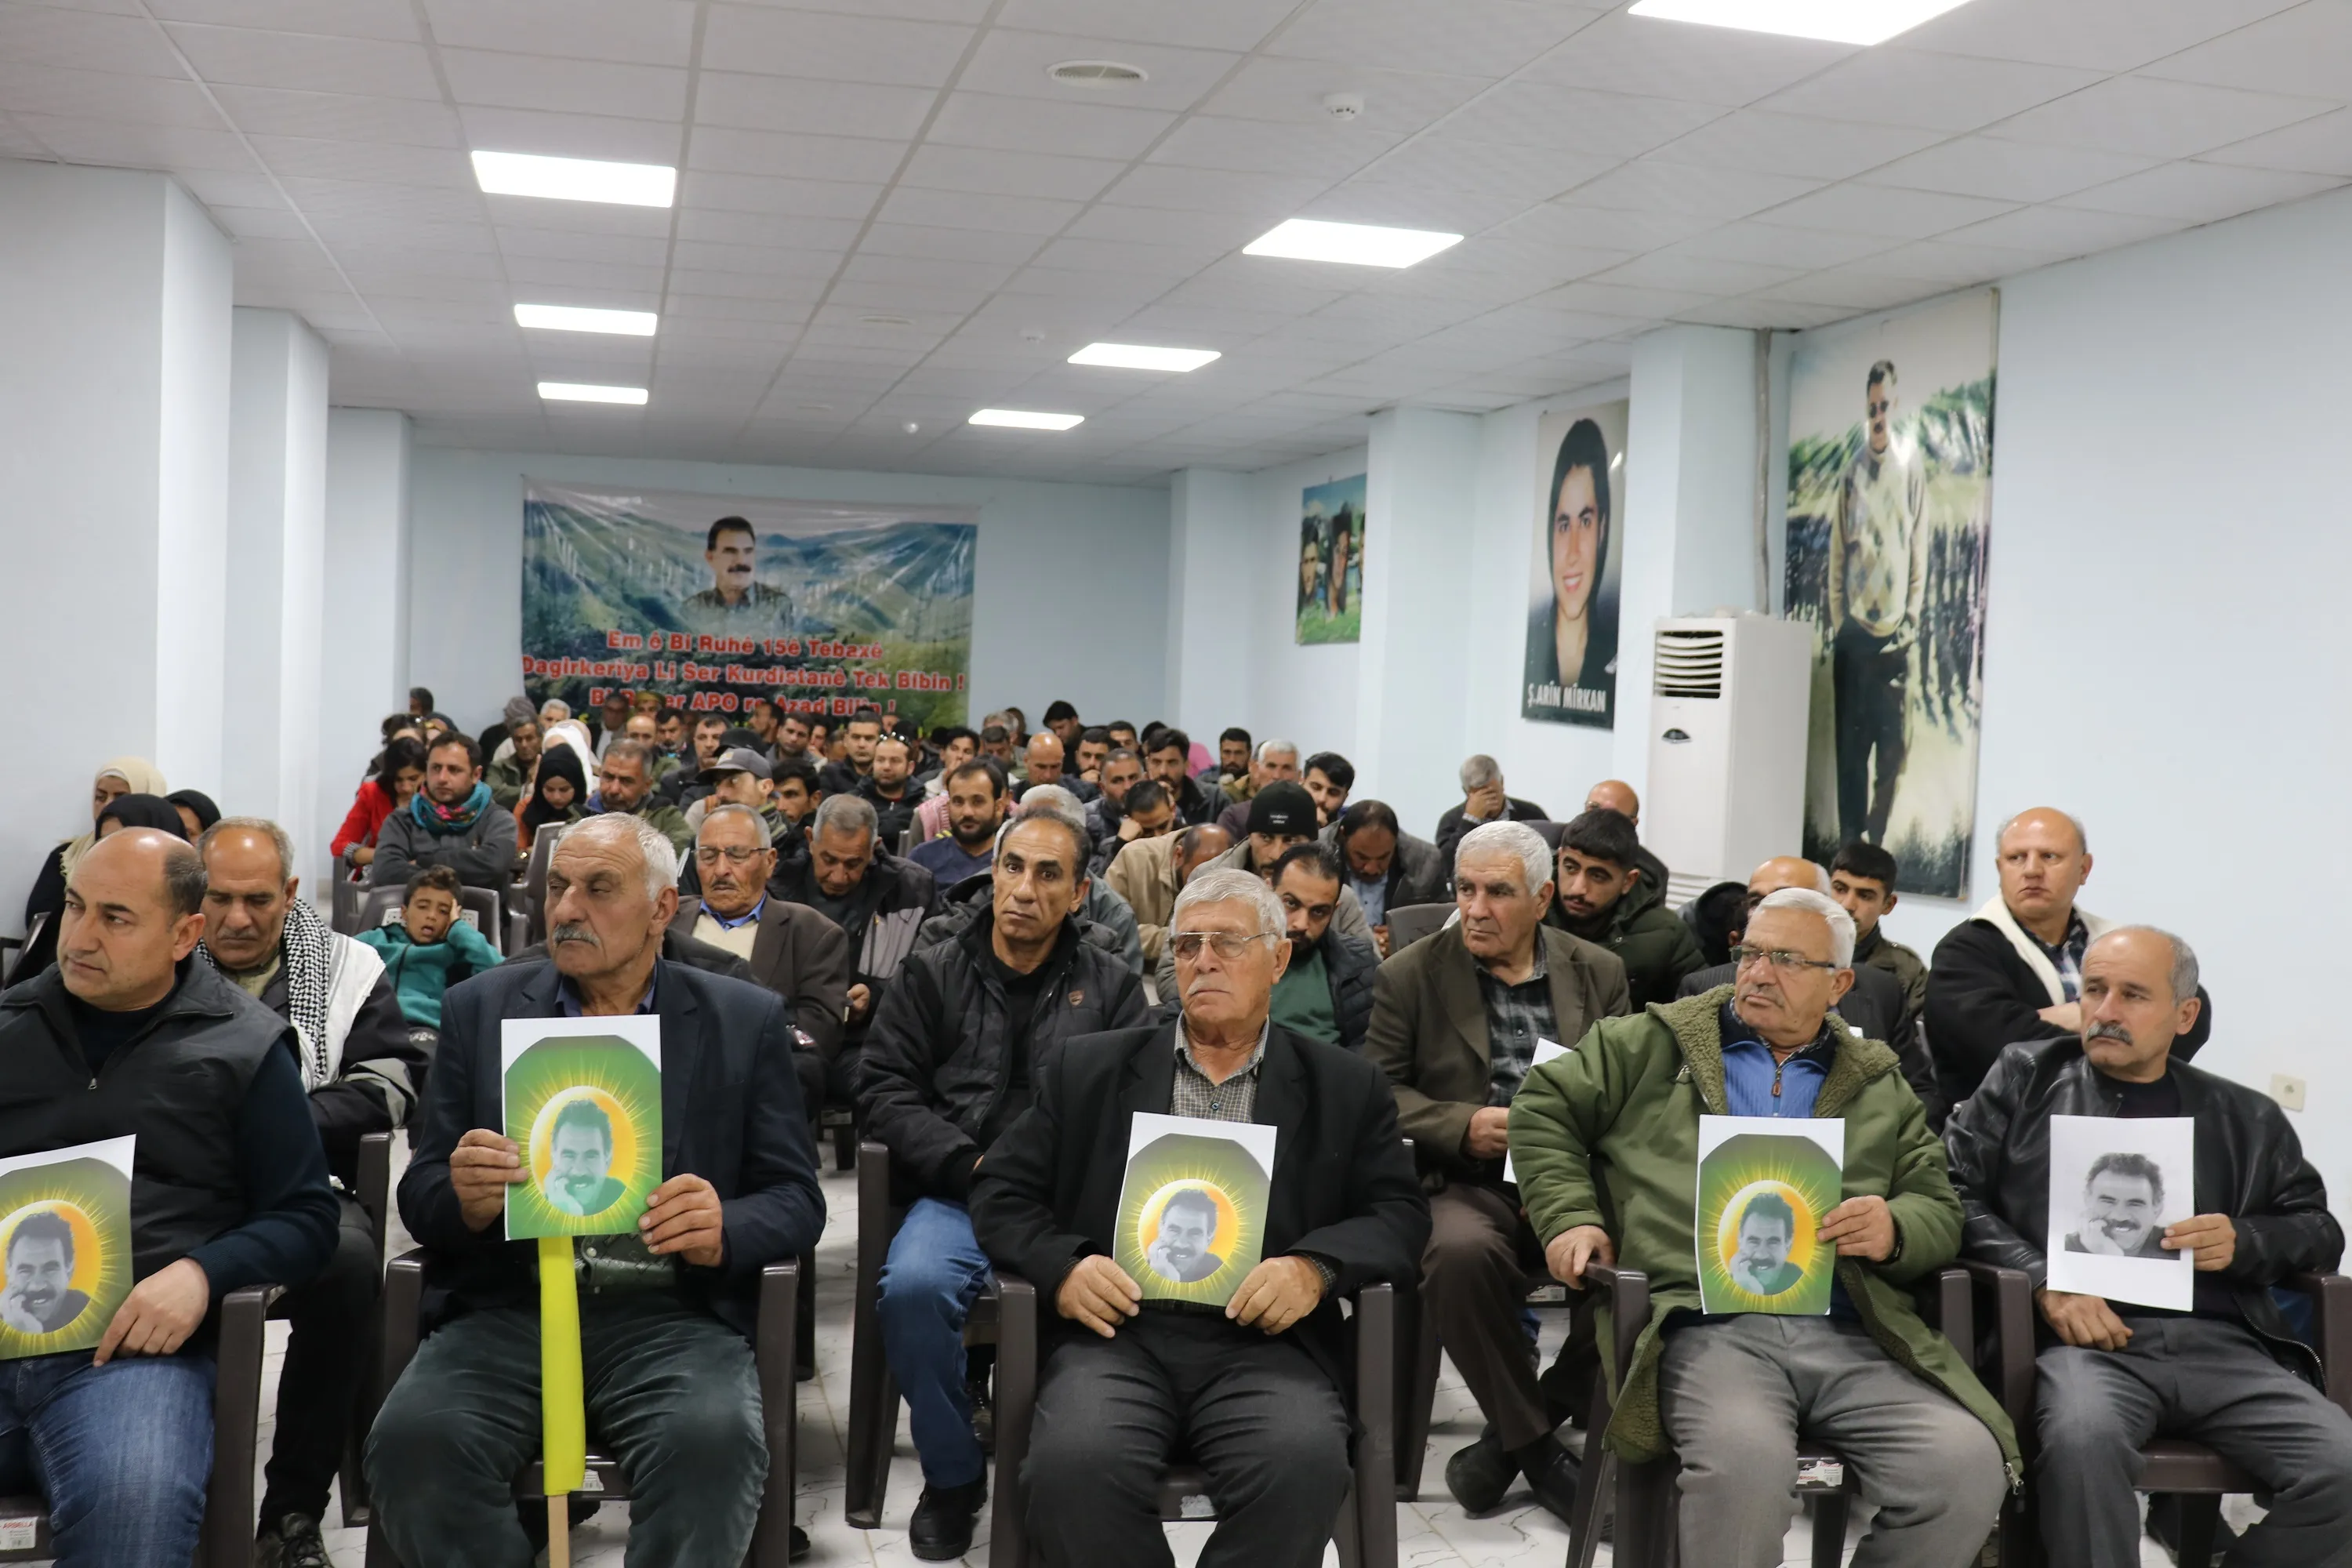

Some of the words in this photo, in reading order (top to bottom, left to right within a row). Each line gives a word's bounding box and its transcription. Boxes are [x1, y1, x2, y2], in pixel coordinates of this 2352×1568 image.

[607, 630, 643, 650] Em
[670, 633, 691, 652] Bi
[699, 634, 755, 655] Ruhê
[764, 638, 801, 657] 15ê
[522, 655, 649, 682] Dagirkeriya
[655, 661, 677, 681] Li
[683, 662, 721, 681] Ser
[727, 663, 847, 688] Kurdistanê
[853, 670, 891, 689] Tek
[897, 671, 952, 691] Bibin
[957, 673, 965, 691] !
[590, 688, 613, 706] B
[691, 691, 739, 712] APO
